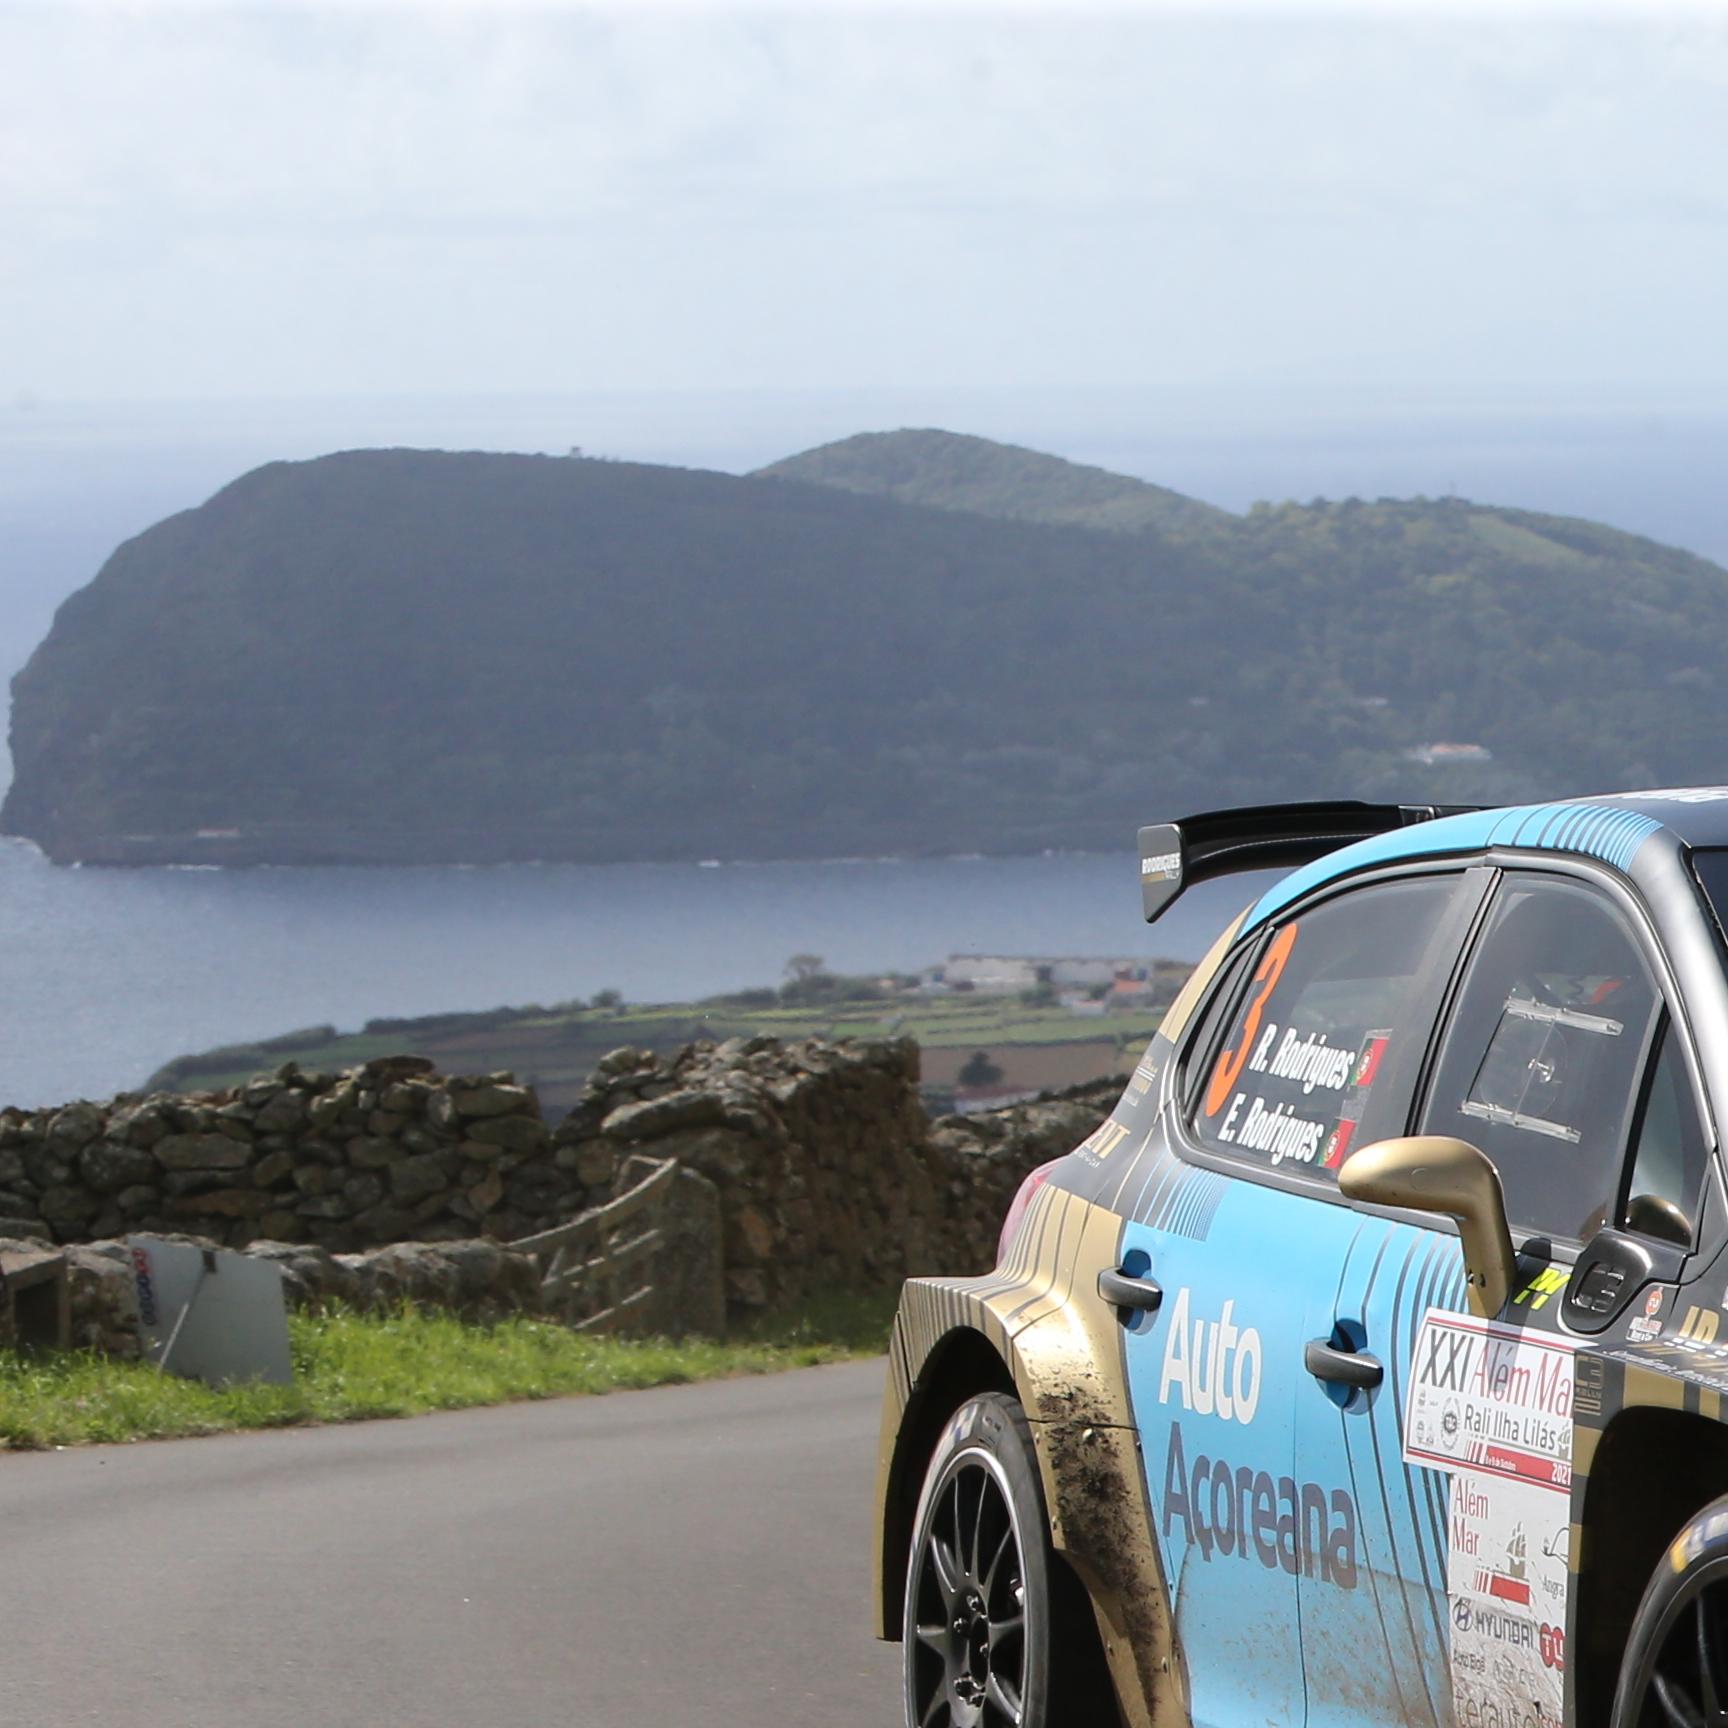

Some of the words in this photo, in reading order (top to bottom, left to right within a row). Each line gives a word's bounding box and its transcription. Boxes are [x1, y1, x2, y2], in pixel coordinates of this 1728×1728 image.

[1205, 922, 1298, 1118] 3
[1248, 1023, 1278, 1073] R.
[1268, 1027, 1356, 1095] Rodrigues
[1217, 1092, 1247, 1143] E.
[1236, 1096, 1325, 1166] Rodrigues
[1159, 1287, 1262, 1426] Auto
[1419, 1328, 1475, 1393] XXI
[1468, 1339, 1532, 1408] Além
[1463, 1403, 1492, 1435] Rali
[1493, 1410, 1520, 1441] Ilha
[1523, 1417, 1557, 1450] Lilás
[1161, 1420, 1358, 1590] Açoreana
[1453, 1477, 1490, 1520] Além
[1551, 1462, 1572, 1486] 2021
[1452, 1515, 1480, 1555] Mar
[1475, 1610, 1535, 1650] HYUNDAI
